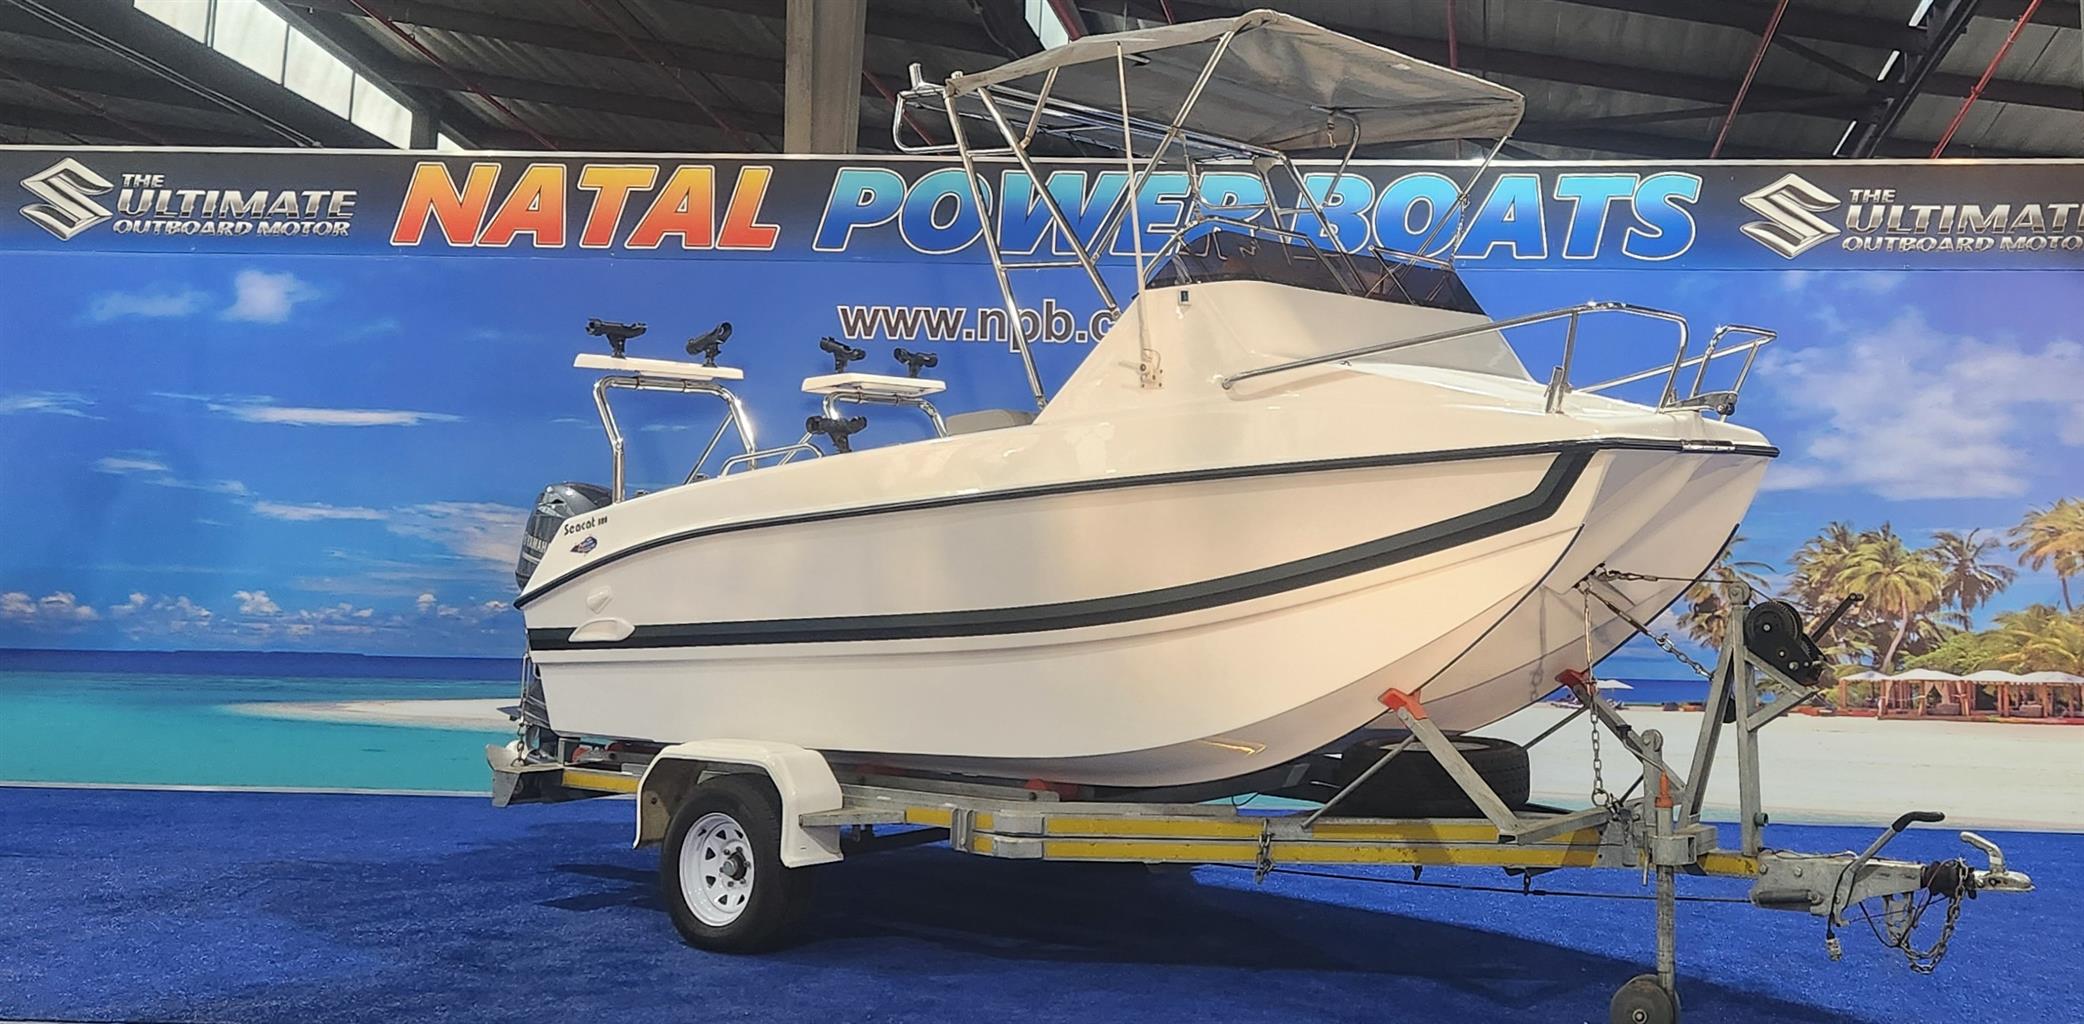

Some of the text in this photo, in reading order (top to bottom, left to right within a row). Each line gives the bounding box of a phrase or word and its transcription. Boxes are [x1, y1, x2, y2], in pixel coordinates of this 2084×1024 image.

[121, 174, 165, 188] THE
[116, 190, 358, 220] ULTIMATE
[1849, 188, 1896, 203] THE
[390, 161, 1703, 261] NATAL POWER BOATS
[1845, 203, 2084, 235] ULTIMAT
[112, 219, 355, 238] OUTBOARD MOTOR
[1842, 235, 1995, 252] OUTBOARD
[564, 516, 596, 536] Seacat
